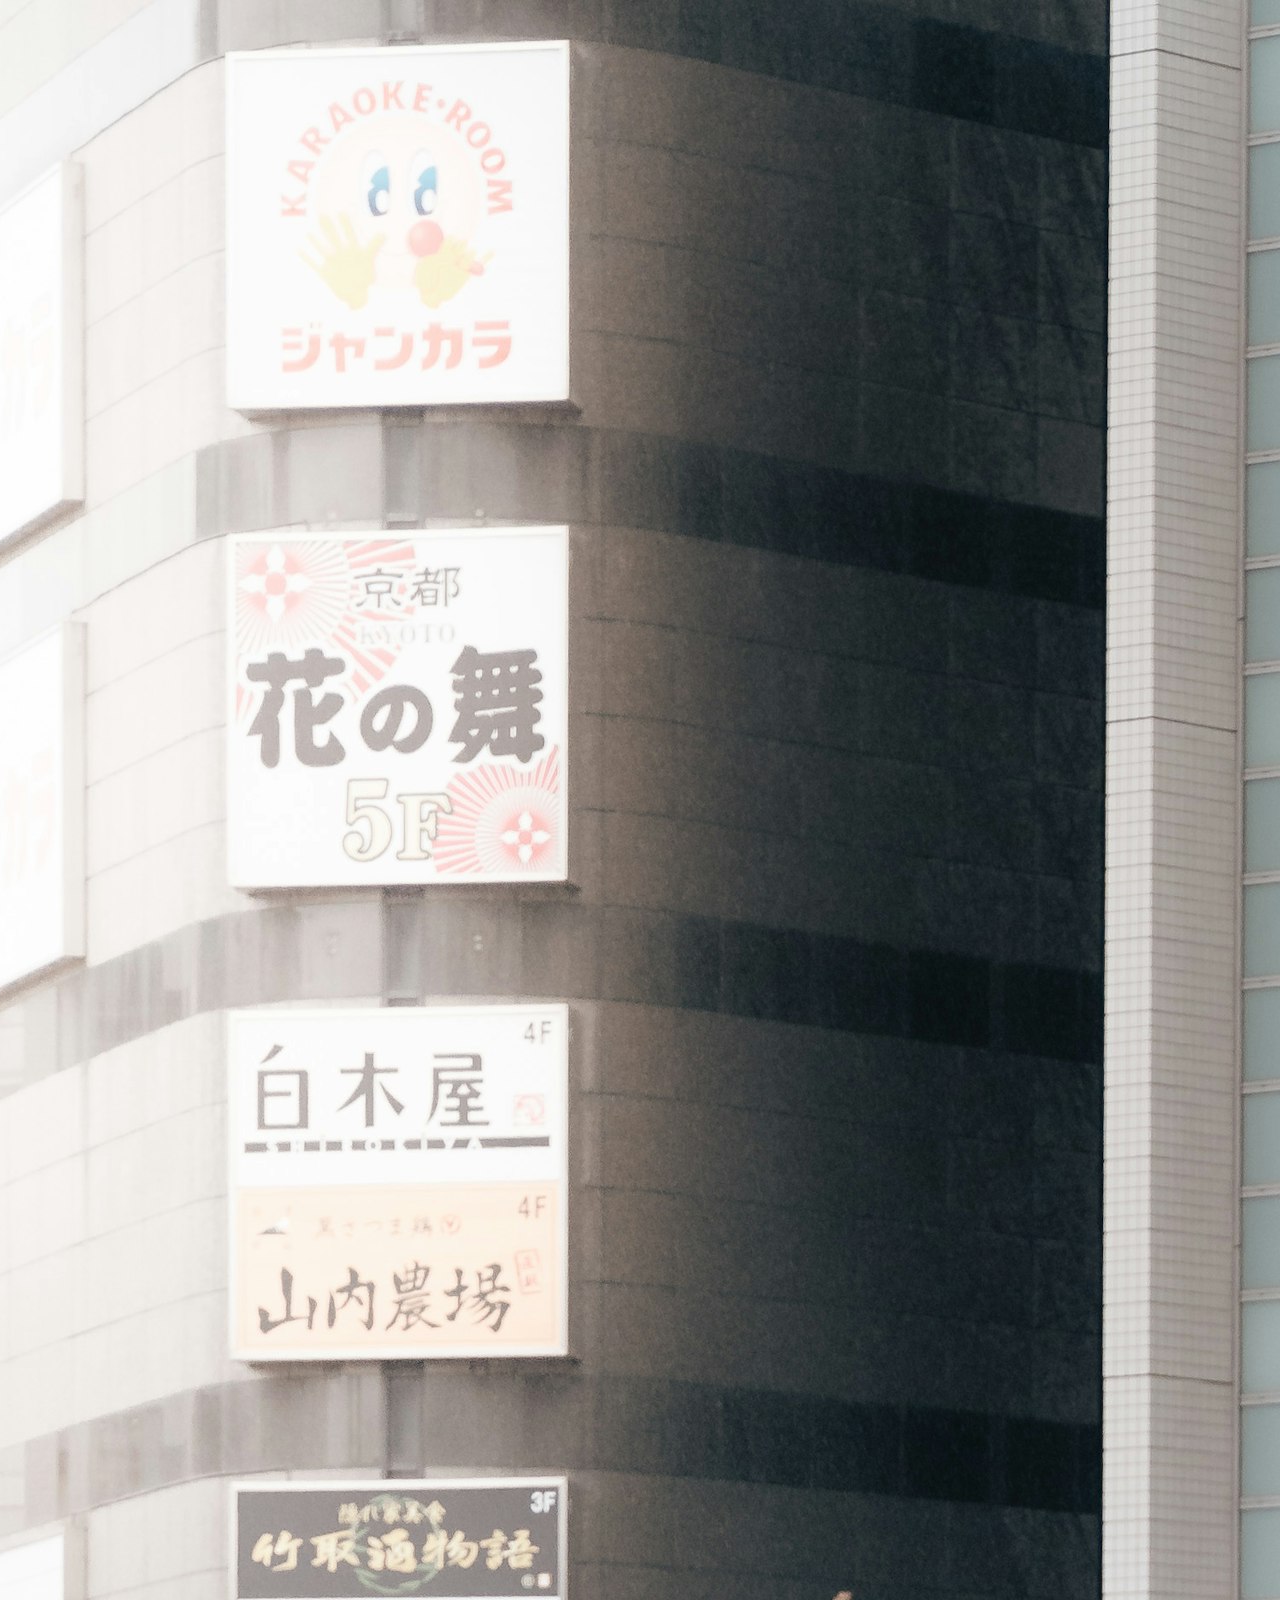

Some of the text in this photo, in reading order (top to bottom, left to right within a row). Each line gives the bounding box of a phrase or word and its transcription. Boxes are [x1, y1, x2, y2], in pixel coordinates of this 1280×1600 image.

[281, 321, 513, 373] ジャンカラ
[353, 567, 462, 608] 京都
[246, 645, 546, 769] 花の舞
[342, 778, 453, 862] 5F
[523, 1020, 552, 1045] 4F
[257, 1044, 490, 1130] 白木屋
[518, 1195, 547, 1219] 4F
[257, 1260, 513, 1334] 山内農場
[529, 1491, 557, 1514] 3F
[251, 1528, 540, 1574] 竹取酒物語
